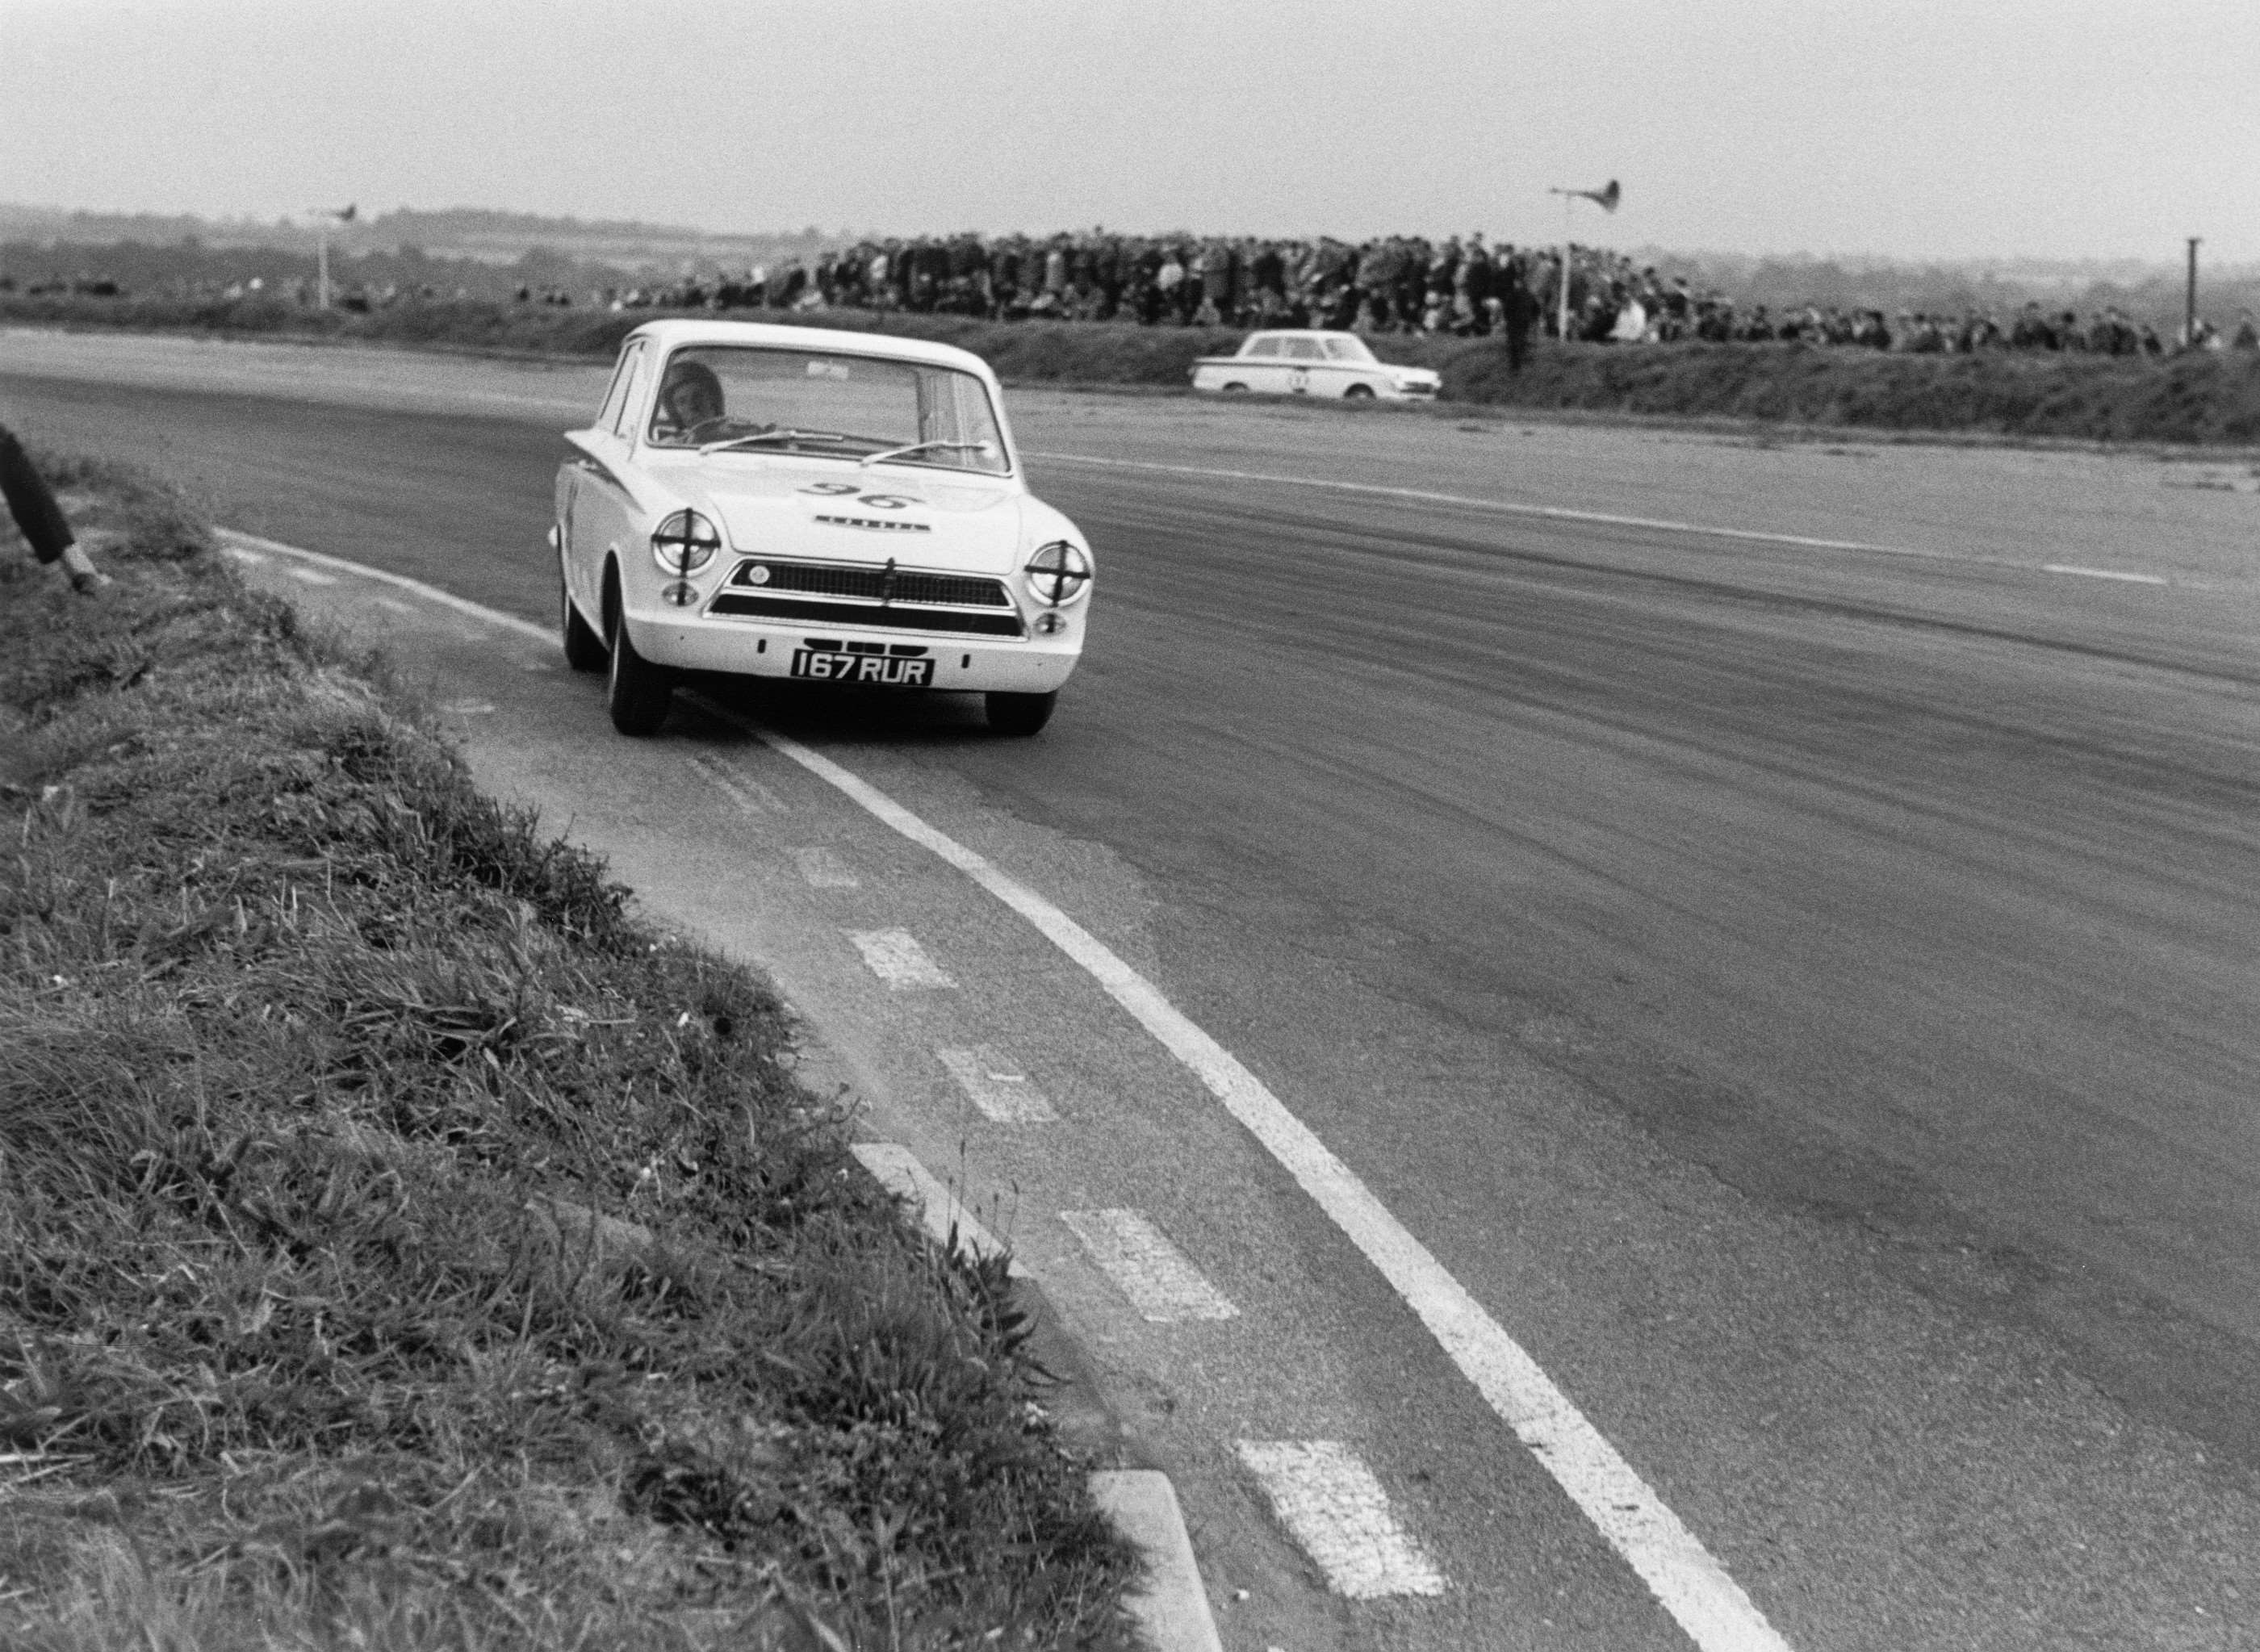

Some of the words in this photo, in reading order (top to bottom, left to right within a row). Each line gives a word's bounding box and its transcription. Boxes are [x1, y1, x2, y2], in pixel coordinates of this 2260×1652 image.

[796, 483, 926, 509] 96
[797, 651, 856, 679] 167
[858, 657, 927, 684] RUR
